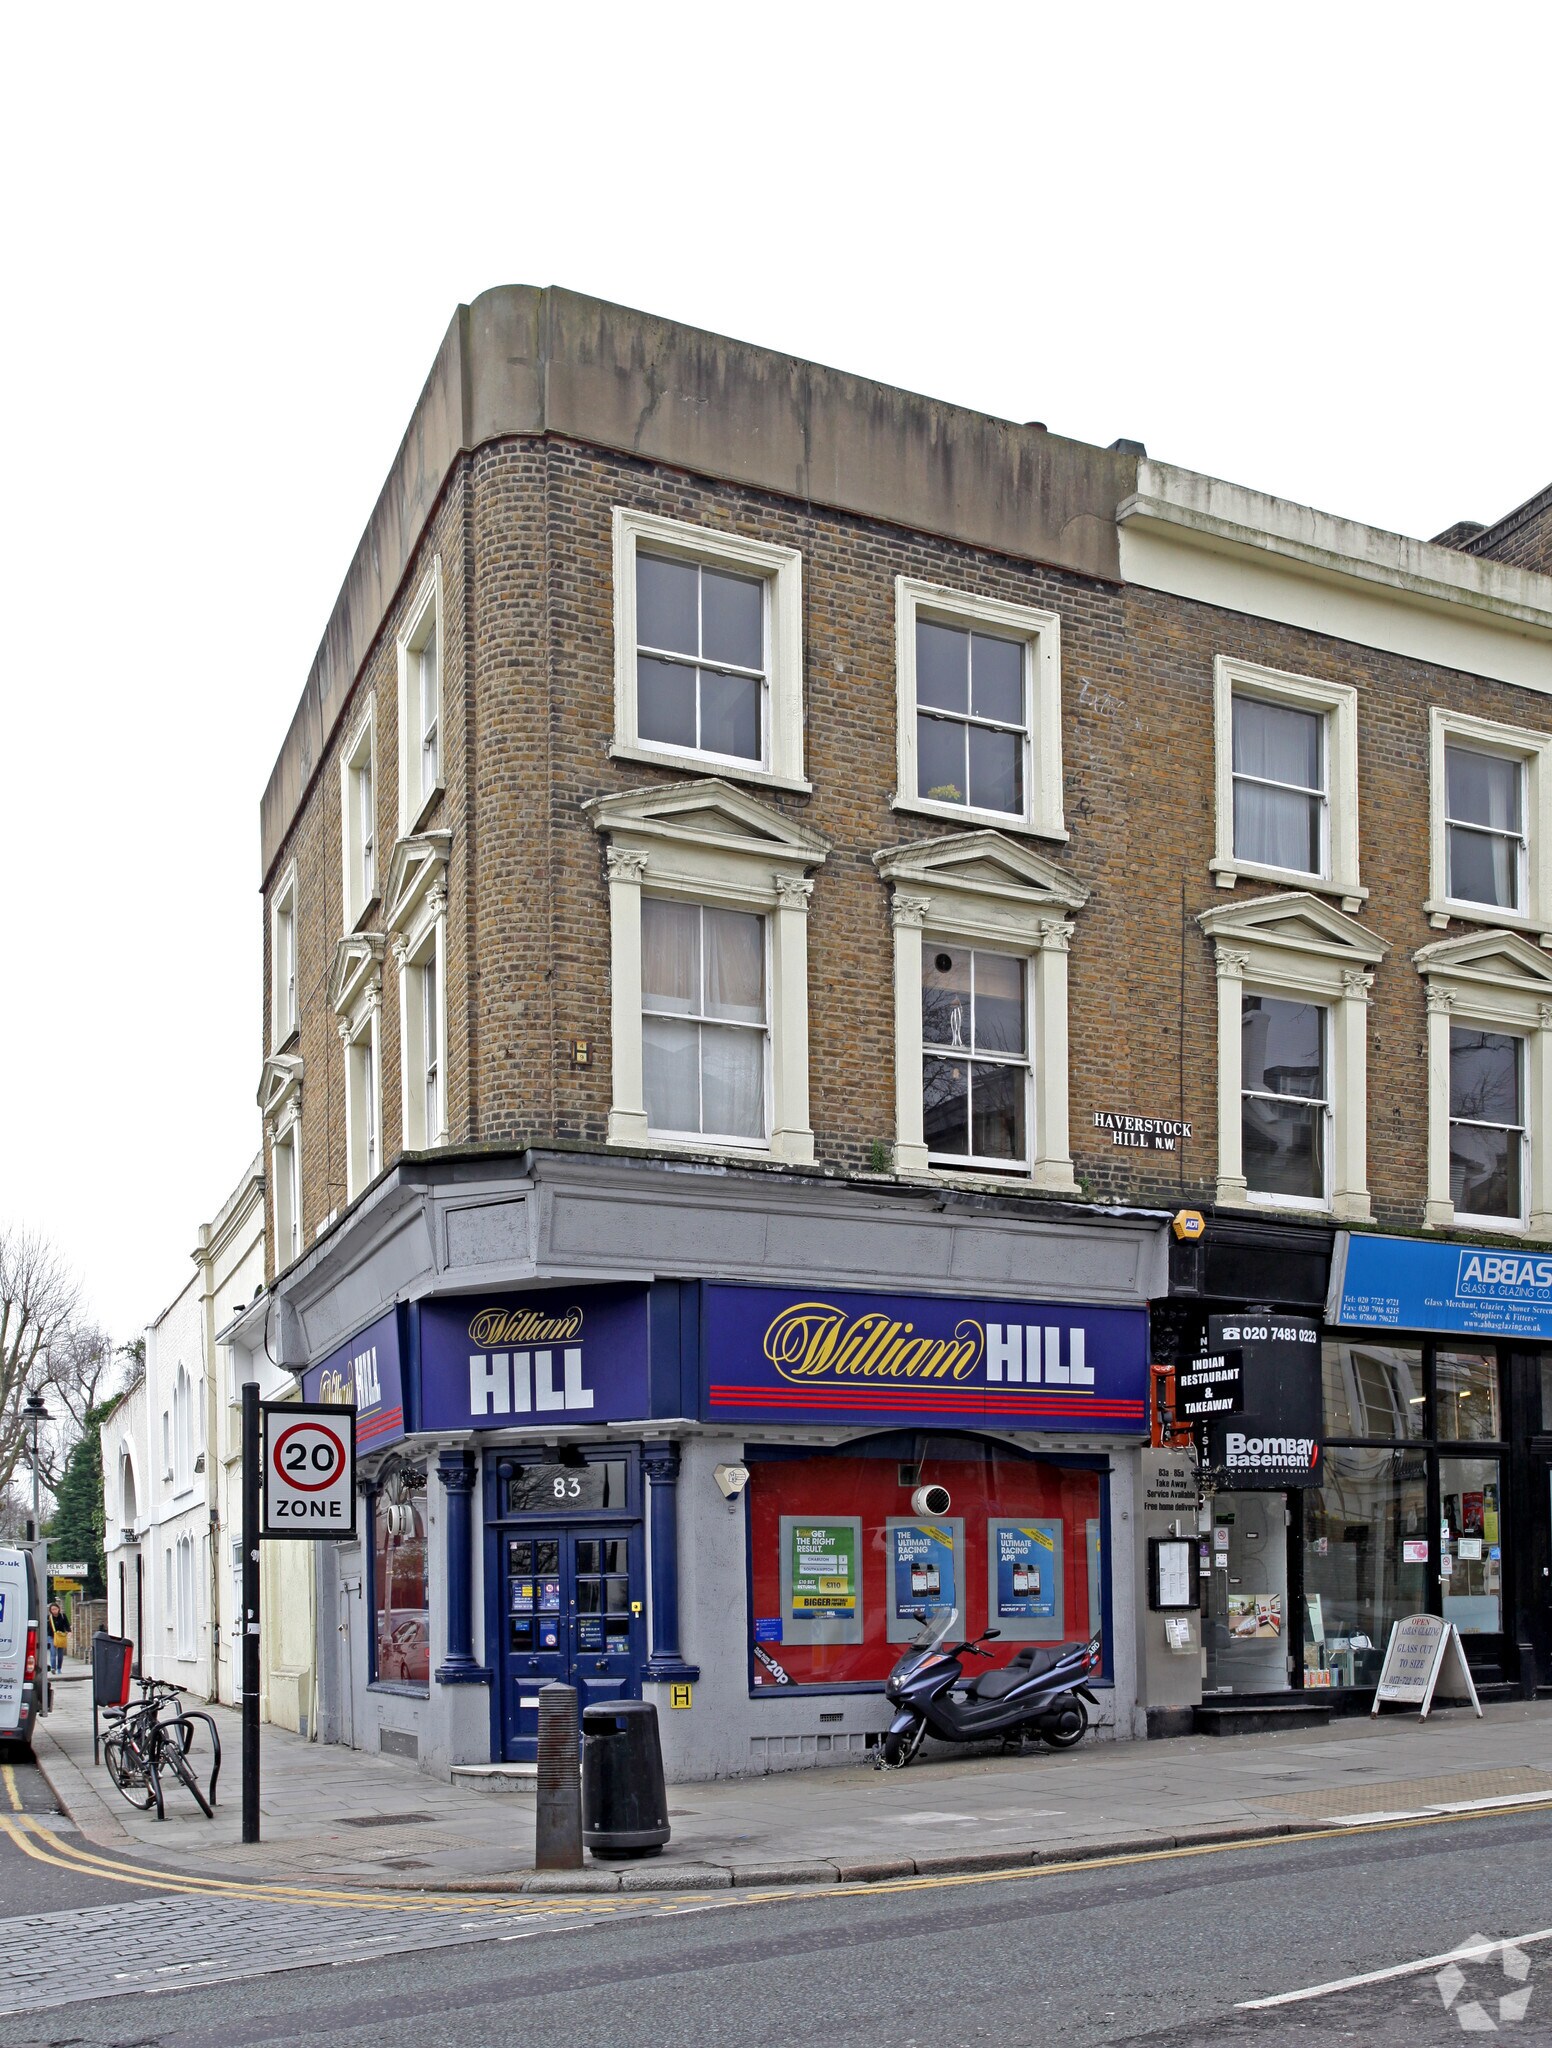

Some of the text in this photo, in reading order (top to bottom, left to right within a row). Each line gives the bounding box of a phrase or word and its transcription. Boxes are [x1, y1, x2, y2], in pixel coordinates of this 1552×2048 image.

[1094, 1112, 1192, 1137] HAVERSTOCK
[1113, 1131, 1176, 1151] HILL N.W.
[1186, 1220, 1198, 1228] ADT
[1462, 1256, 1552, 1288] ABBAS
[1344, 1294, 1356, 1302] Tel:
[1460, 1282, 1552, 1298] GLASS & GLAZING CO.
[1424, 1298, 1442, 1306] Glass
[1446, 1300, 1478, 1309] Merchant,
[1480, 1302, 1506, 1312] Glazier,
[1508, 1304, 1530, 1313] Shower
[1342, 1312, 1357, 1320] Mob:
[468, 1306, 584, 1348] William
[1464, 1320, 1541, 1332] www.abbasglazing.co.uk
[764, 1302, 1094, 1384] William HILL
[1242, 1327, 1317, 1343] 020 7483 0223
[1192, 1356, 1224, 1370] INDIAN
[355, 1346, 381, 1412] HILL
[470, 1348, 594, 1416] HILL
[1181, 1368, 1240, 1386] RESTAURANT
[1204, 1387, 1213, 1398] &
[1185, 1398, 1233, 1414] TAKEAWAY
[286, 1443, 334, 1471] 20
[1226, 1454, 1309, 1466] Basement
[1158, 1468, 1169, 1477] 83a
[1174, 1469, 1184, 1477] 85a
[554, 1477, 581, 1498] 83
[1156, 1479, 1187, 1489] Take Away
[1147, 1490, 1169, 1498] Service
[276, 1500, 342, 1517] ZONE
[1144, 1502, 1157, 1510] Free
[804, 1598, 830, 1606] BIGGER
[1397, 1644, 1433, 1654] GLASS CUT
[1400, 1659, 1425, 1668] TO SIZE
[766, 1660, 788, 1684] 20p
[674, 1686, 689, 1705] H
